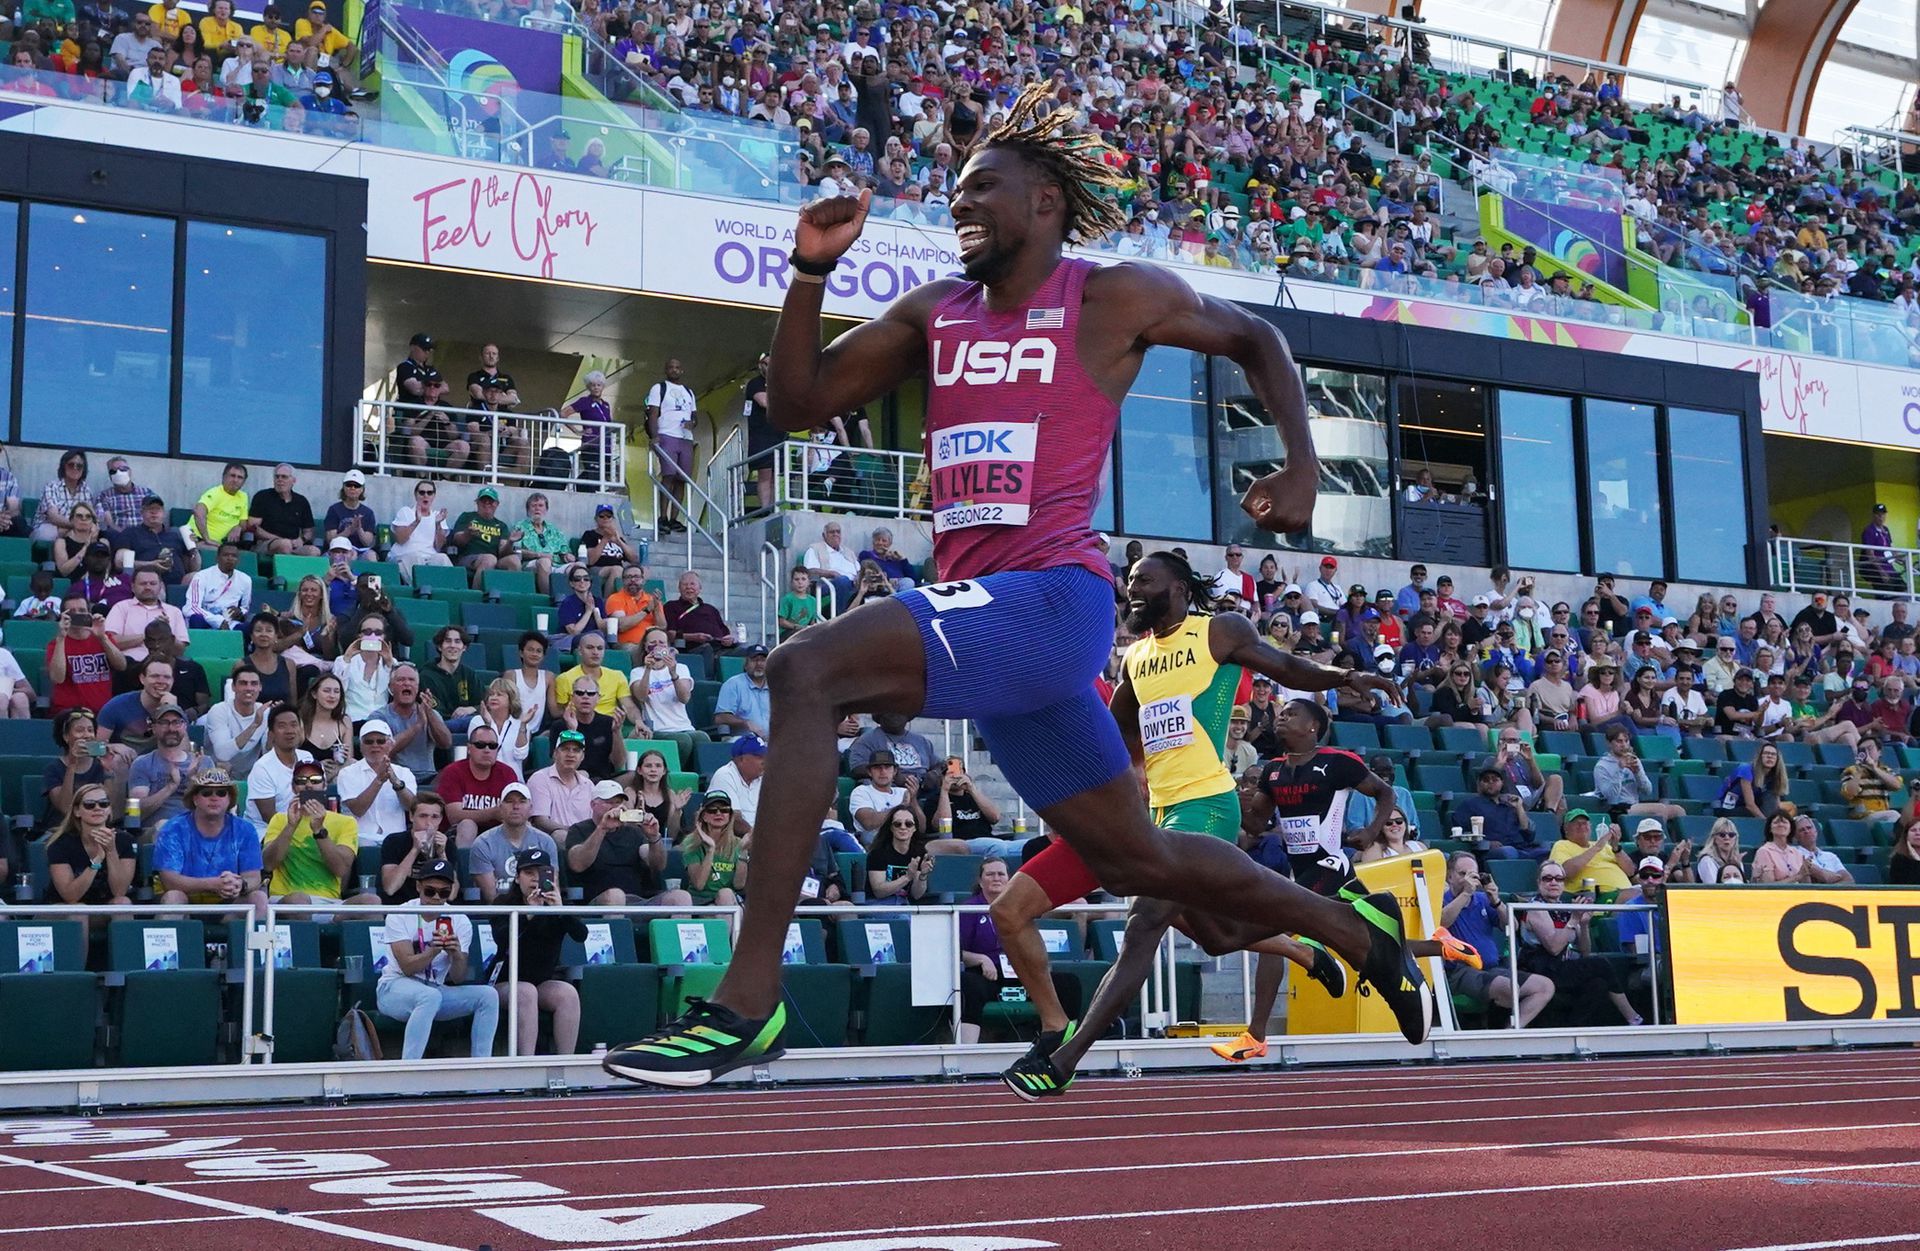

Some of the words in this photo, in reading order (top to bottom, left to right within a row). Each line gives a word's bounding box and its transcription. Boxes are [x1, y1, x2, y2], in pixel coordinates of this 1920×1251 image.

[413, 178, 491, 264] Feel
[483, 175, 509, 207] the
[511, 173, 597, 279] Glory
[715, 218, 777, 241] WORLD
[876, 241, 965, 267] CHAMPION
[933, 337, 1057, 387] USA
[1765, 355, 1778, 380] the
[1780, 354, 1828, 435] Glory
[950, 430, 1013, 457] TDK
[952, 463, 1023, 498] LYLES
[942, 506, 1003, 528] OREGON22
[68, 652, 111, 675] USA
[1133, 648, 1196, 680] JAMAICA
[1150, 700, 1181, 717] TDK
[1144, 716, 1185, 740] DWYER
[1287, 818, 1312, 829] TDK
[12, 1129, 171, 1144] 8
[89, 1138, 278, 1159] 7
[309, 1172, 571, 1206] 5
[472, 1203, 766, 1243] 4
